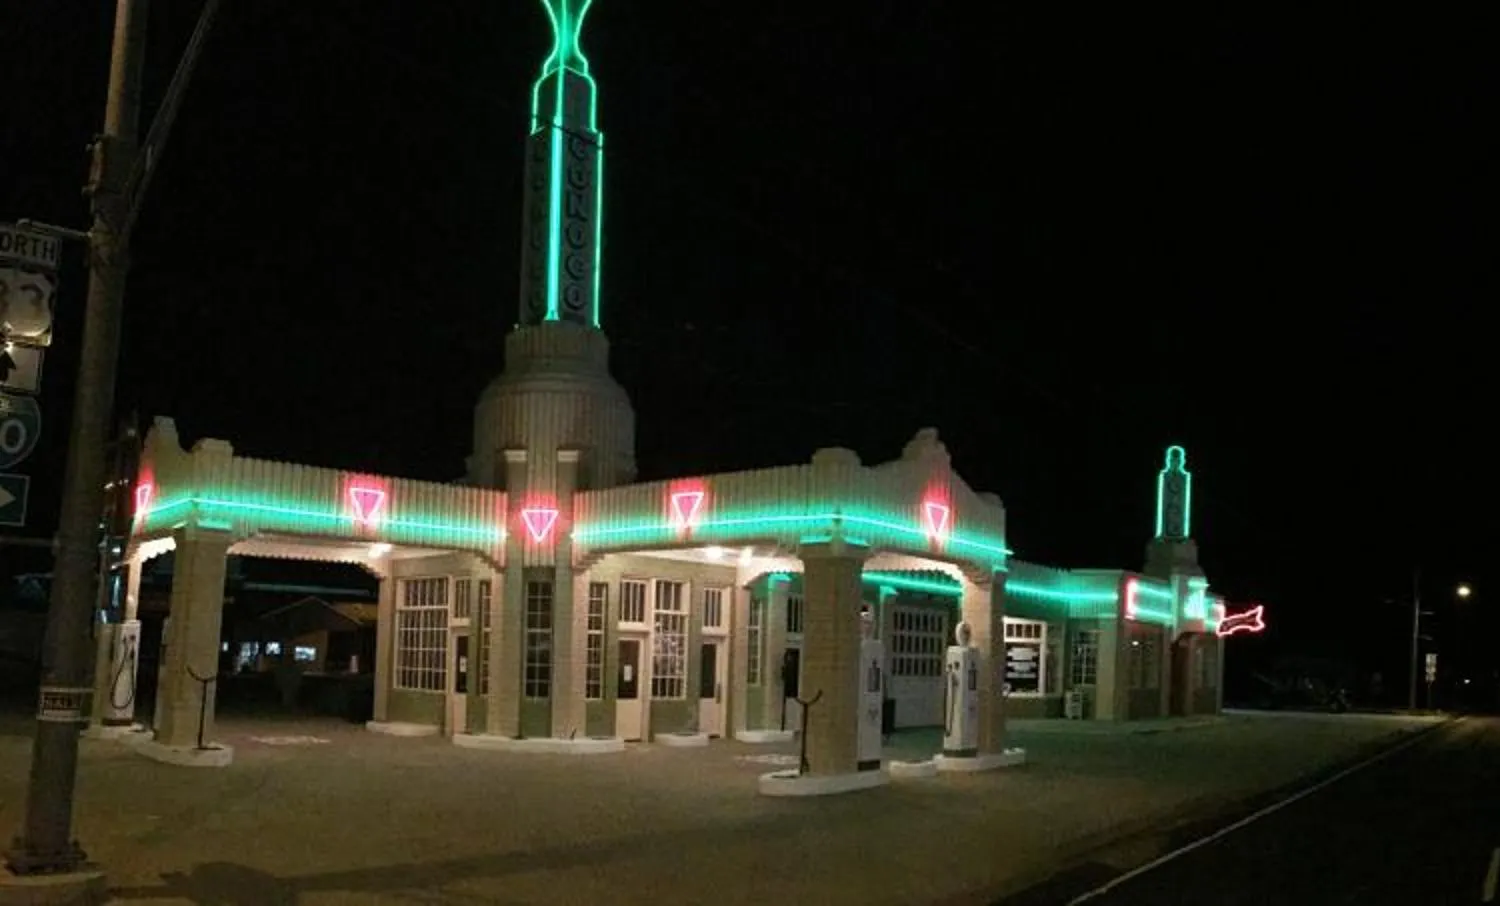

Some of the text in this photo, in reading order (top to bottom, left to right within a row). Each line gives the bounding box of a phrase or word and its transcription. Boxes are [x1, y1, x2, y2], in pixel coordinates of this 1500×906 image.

[563, 136, 590, 311] CONOCO
[0, 232, 55, 261] ORTH
[0, 418, 28, 454] 0
